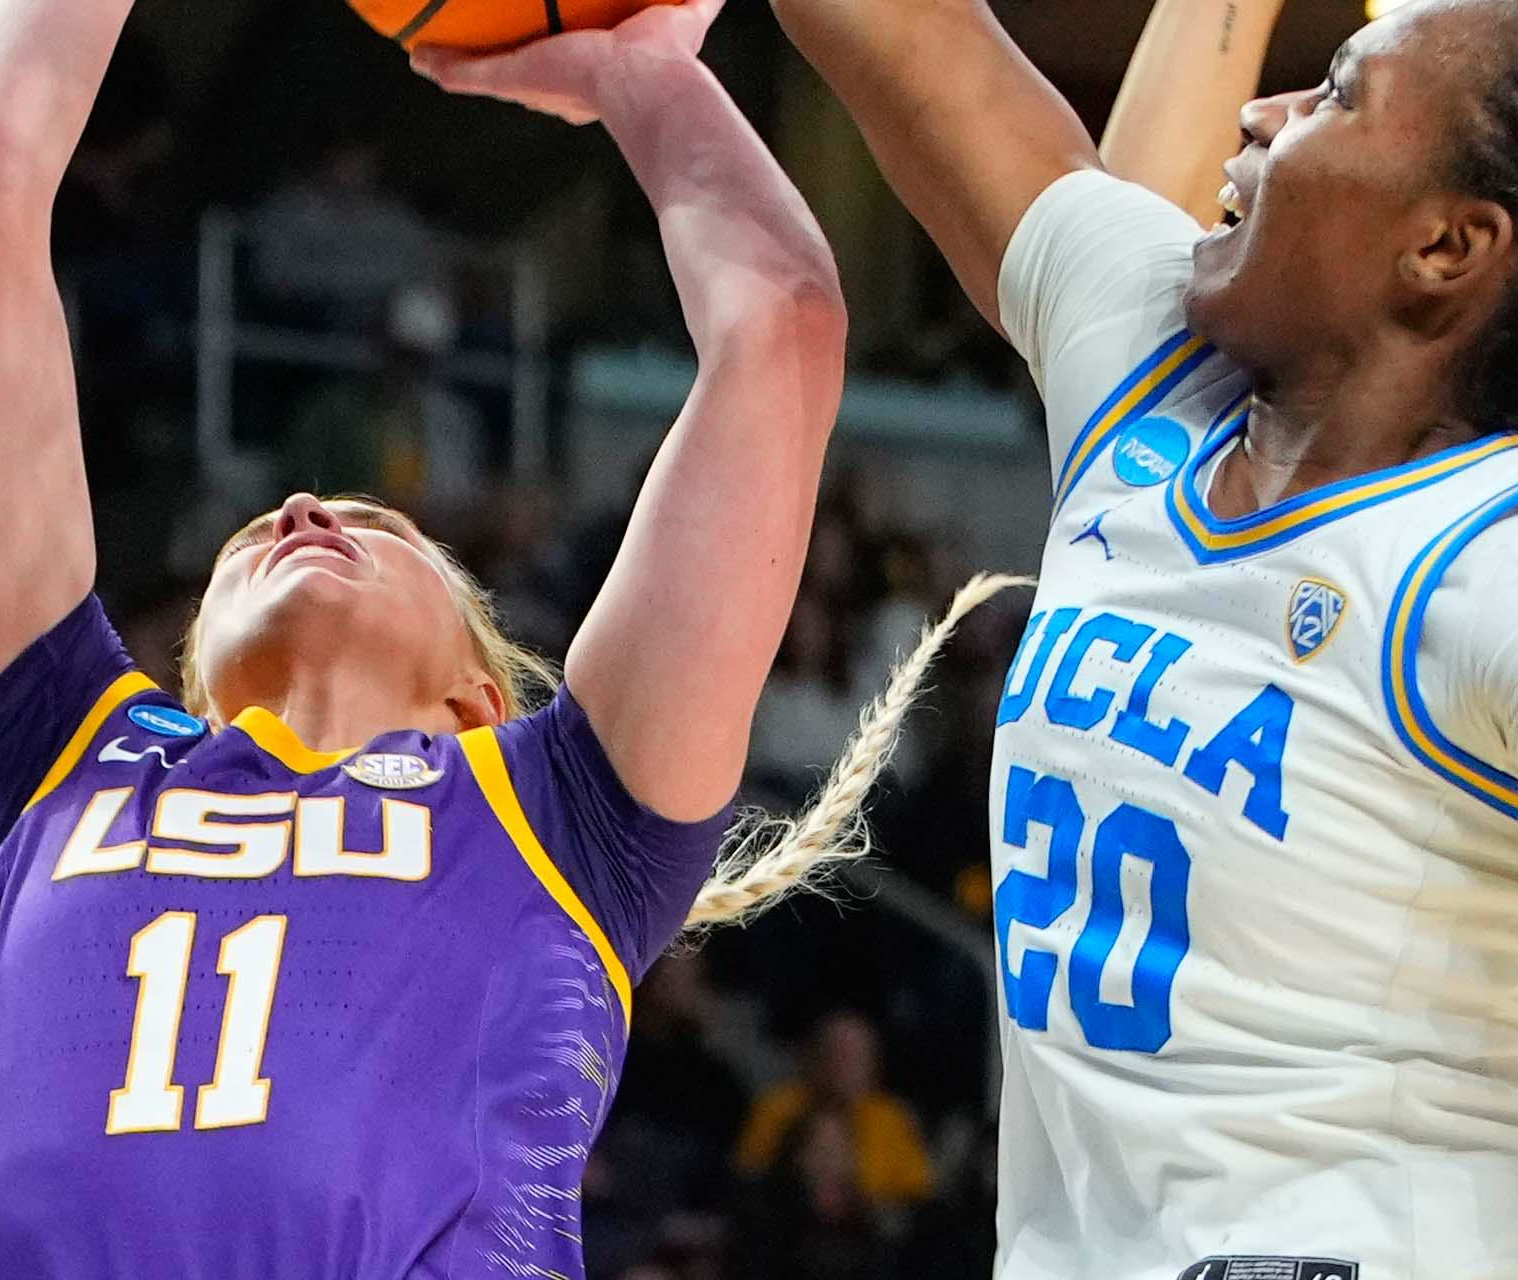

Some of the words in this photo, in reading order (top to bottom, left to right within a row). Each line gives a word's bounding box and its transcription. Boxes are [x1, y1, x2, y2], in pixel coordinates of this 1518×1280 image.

[1121, 437, 1178, 479] NCAA
[1292, 615, 1324, 649] 12
[362, 755, 423, 777] SEC
[997, 605, 1295, 841] UCLA
[52, 786, 432, 882] LSU
[995, 766, 1192, 1054] 20
[106, 910, 287, 1136] 11
